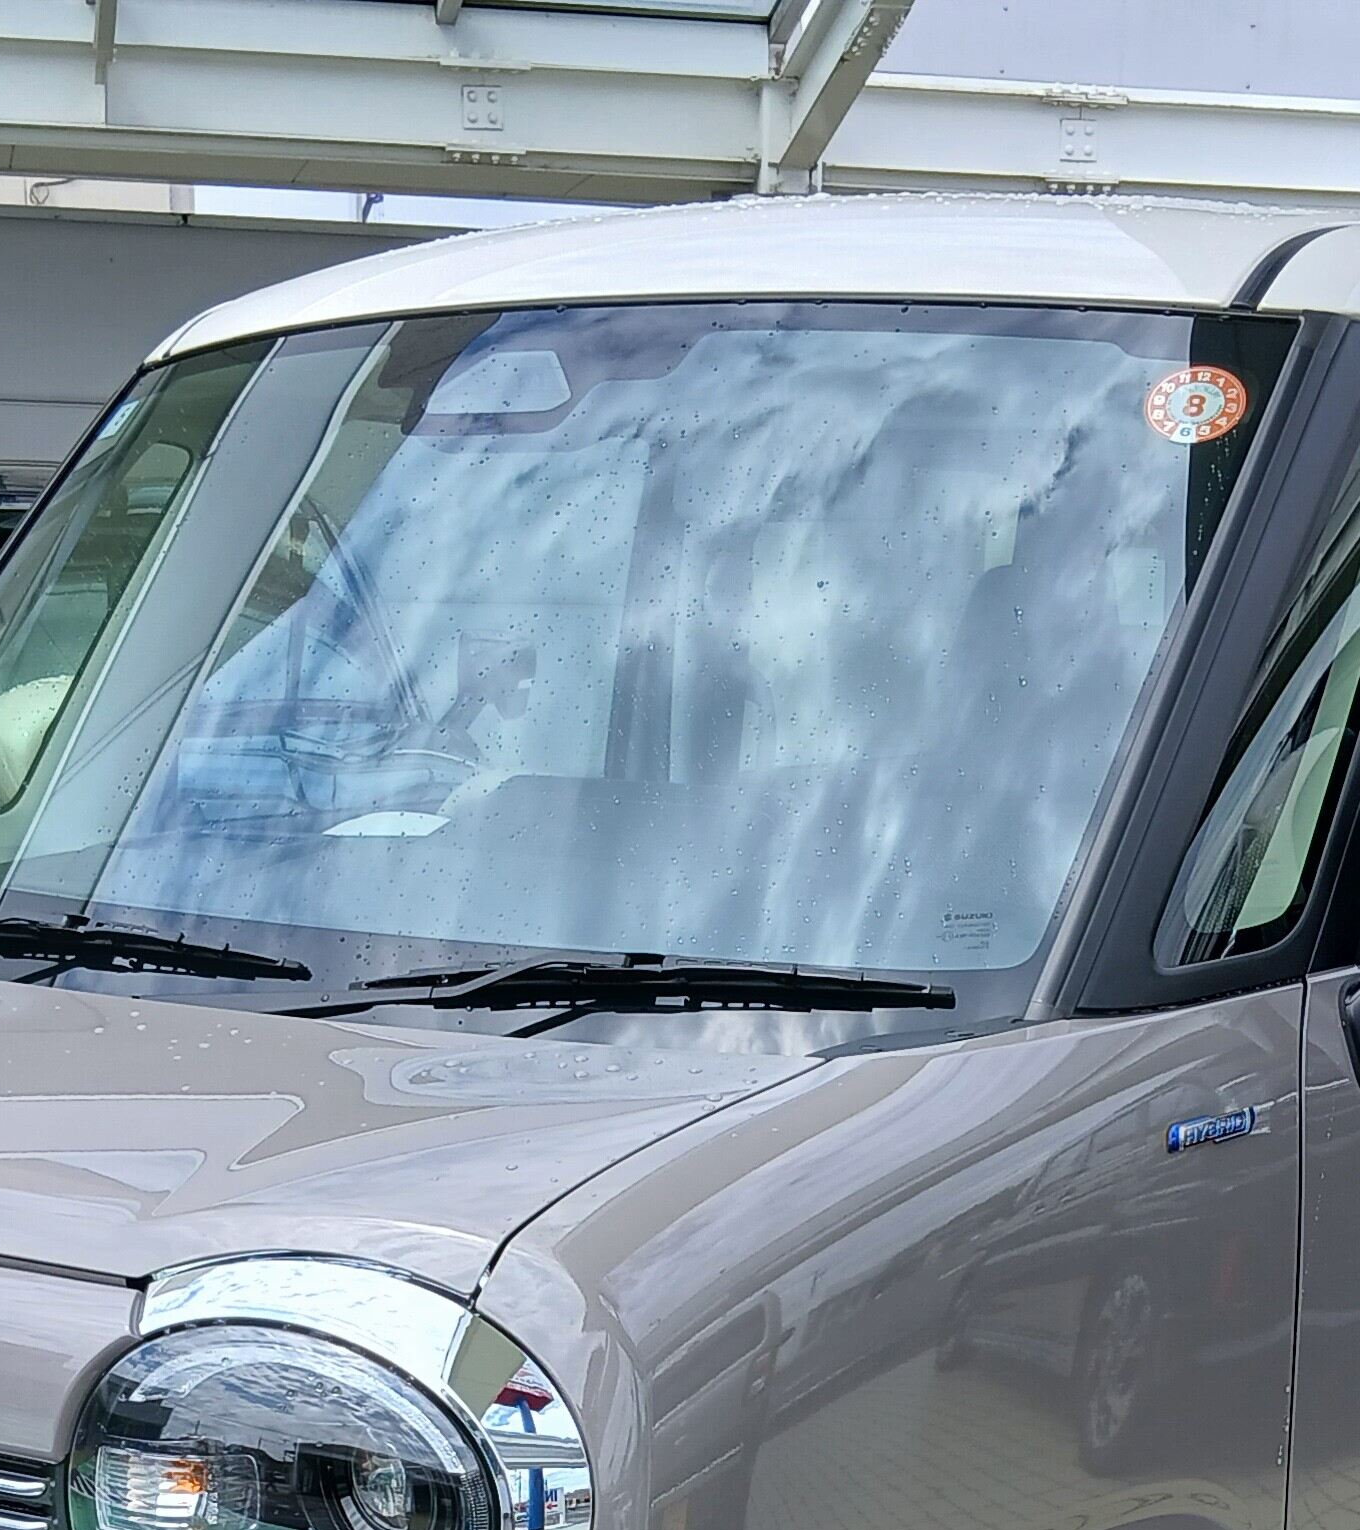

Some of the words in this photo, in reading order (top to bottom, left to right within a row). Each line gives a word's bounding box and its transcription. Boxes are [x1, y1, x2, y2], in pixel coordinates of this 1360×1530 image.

[1178, 373, 1191, 383] 11
[1197, 371, 1211, 382] 12
[1216, 377, 1225, 387] 1
[1161, 382, 1176, 393] 10
[1227, 388, 1238, 399] 2
[1225, 403, 1237, 413] 3
[1163, 421, 1176, 432] 7
[1215, 417, 1228, 427] 4
[1180, 427, 1192, 437] 6
[1197, 425, 1211, 435] 5
[954, 912, 993, 920] SUZUKI
